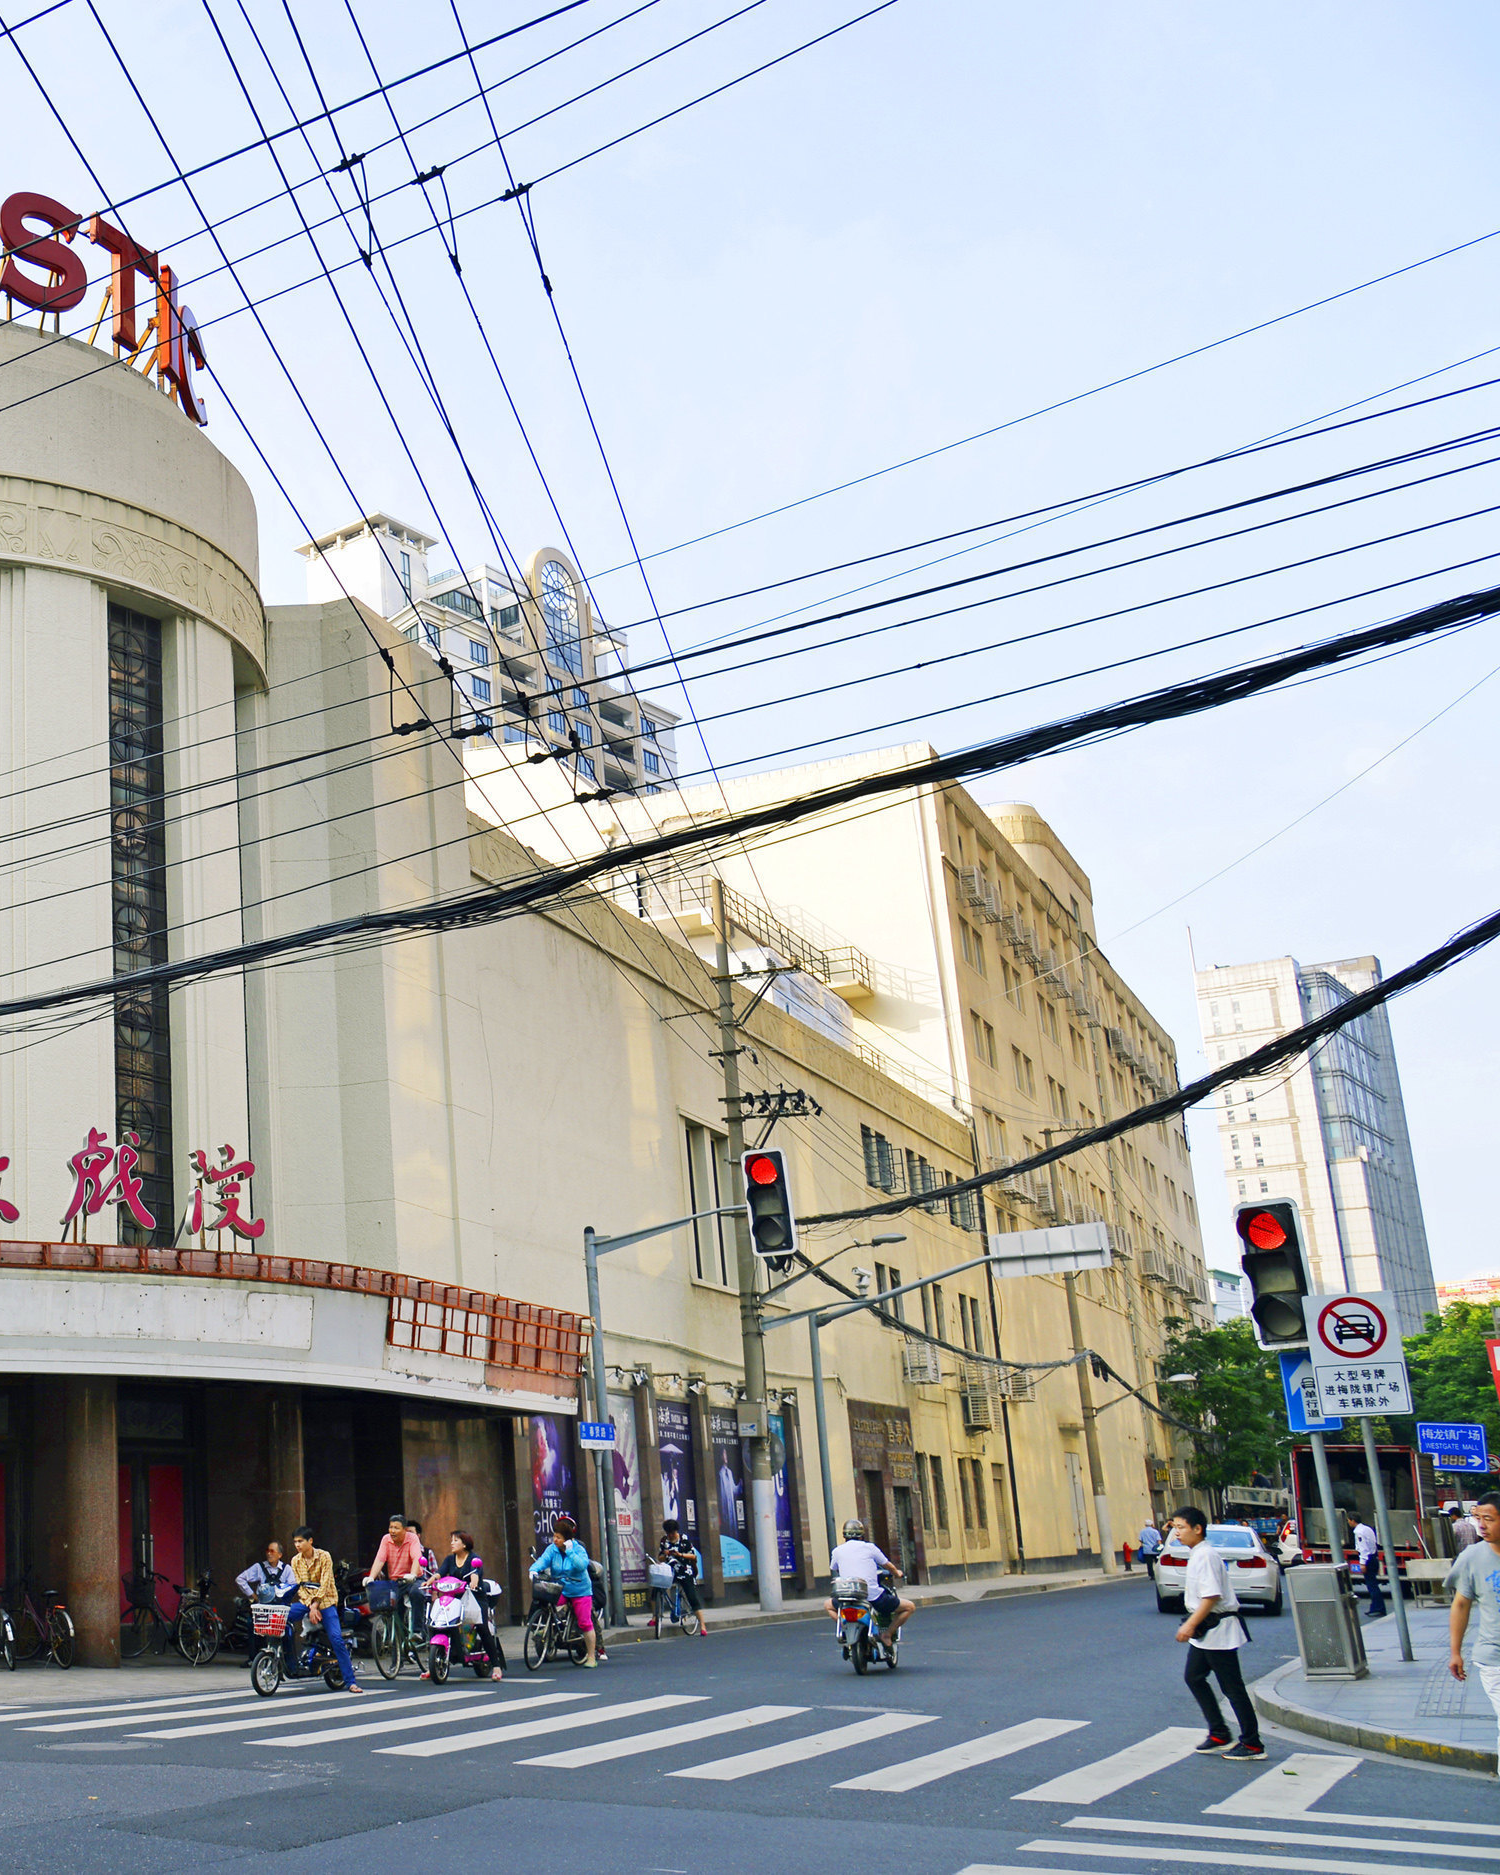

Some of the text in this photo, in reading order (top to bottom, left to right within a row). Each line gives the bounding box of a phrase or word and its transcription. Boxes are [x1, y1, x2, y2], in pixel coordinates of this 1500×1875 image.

[1333, 1369, 1386, 1382] 大型号牌
[1325, 1381, 1400, 1396] 进梅陇镇广场
[1304, 1390, 1321, 1418] 单行道
[1338, 1396, 1391, 1409] 车辆除外
[1421, 1427, 1481, 1441] 梅龙镇广场
[1425, 1442, 1460, 1451] WESTGATE
[533, 1510, 571, 1534] GHO
